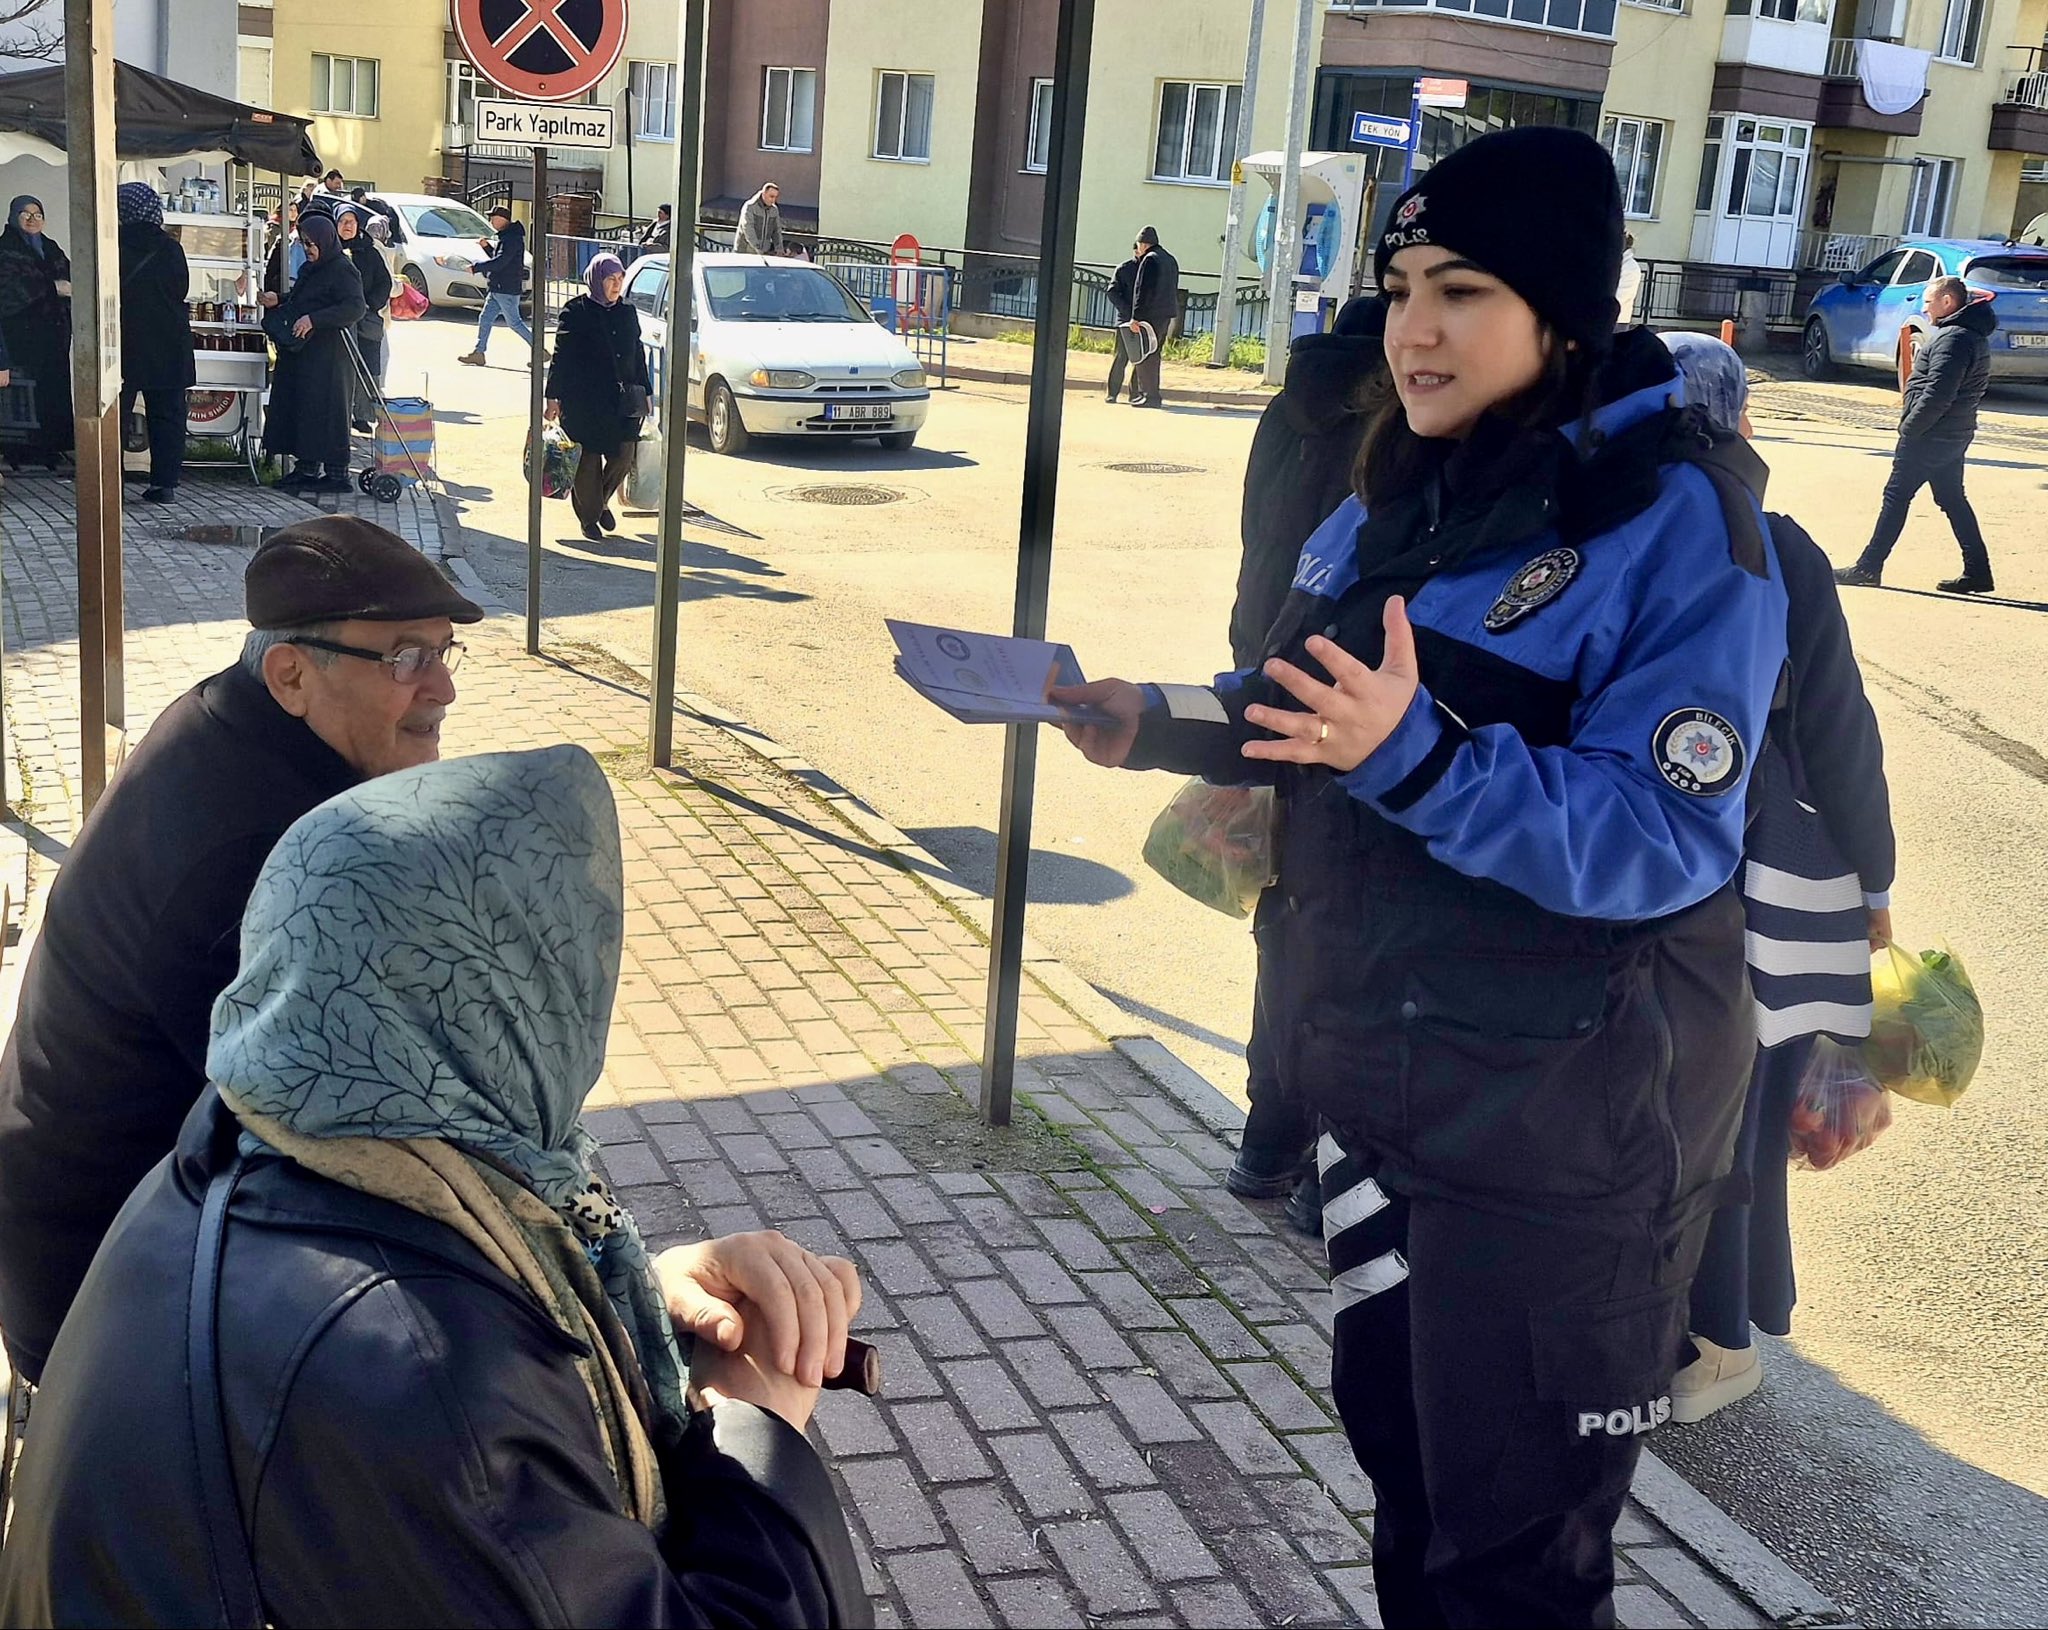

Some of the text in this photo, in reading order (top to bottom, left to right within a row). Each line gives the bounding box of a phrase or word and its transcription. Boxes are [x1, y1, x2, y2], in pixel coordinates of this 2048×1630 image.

[485, 110, 606, 139] Park Yapılmaz
[1362, 123, 1400, 138] TEK YÖN
[1384, 228, 1430, 250] POLİS
[849, 406, 866, 418] ABR
[872, 406, 889, 418] 889
